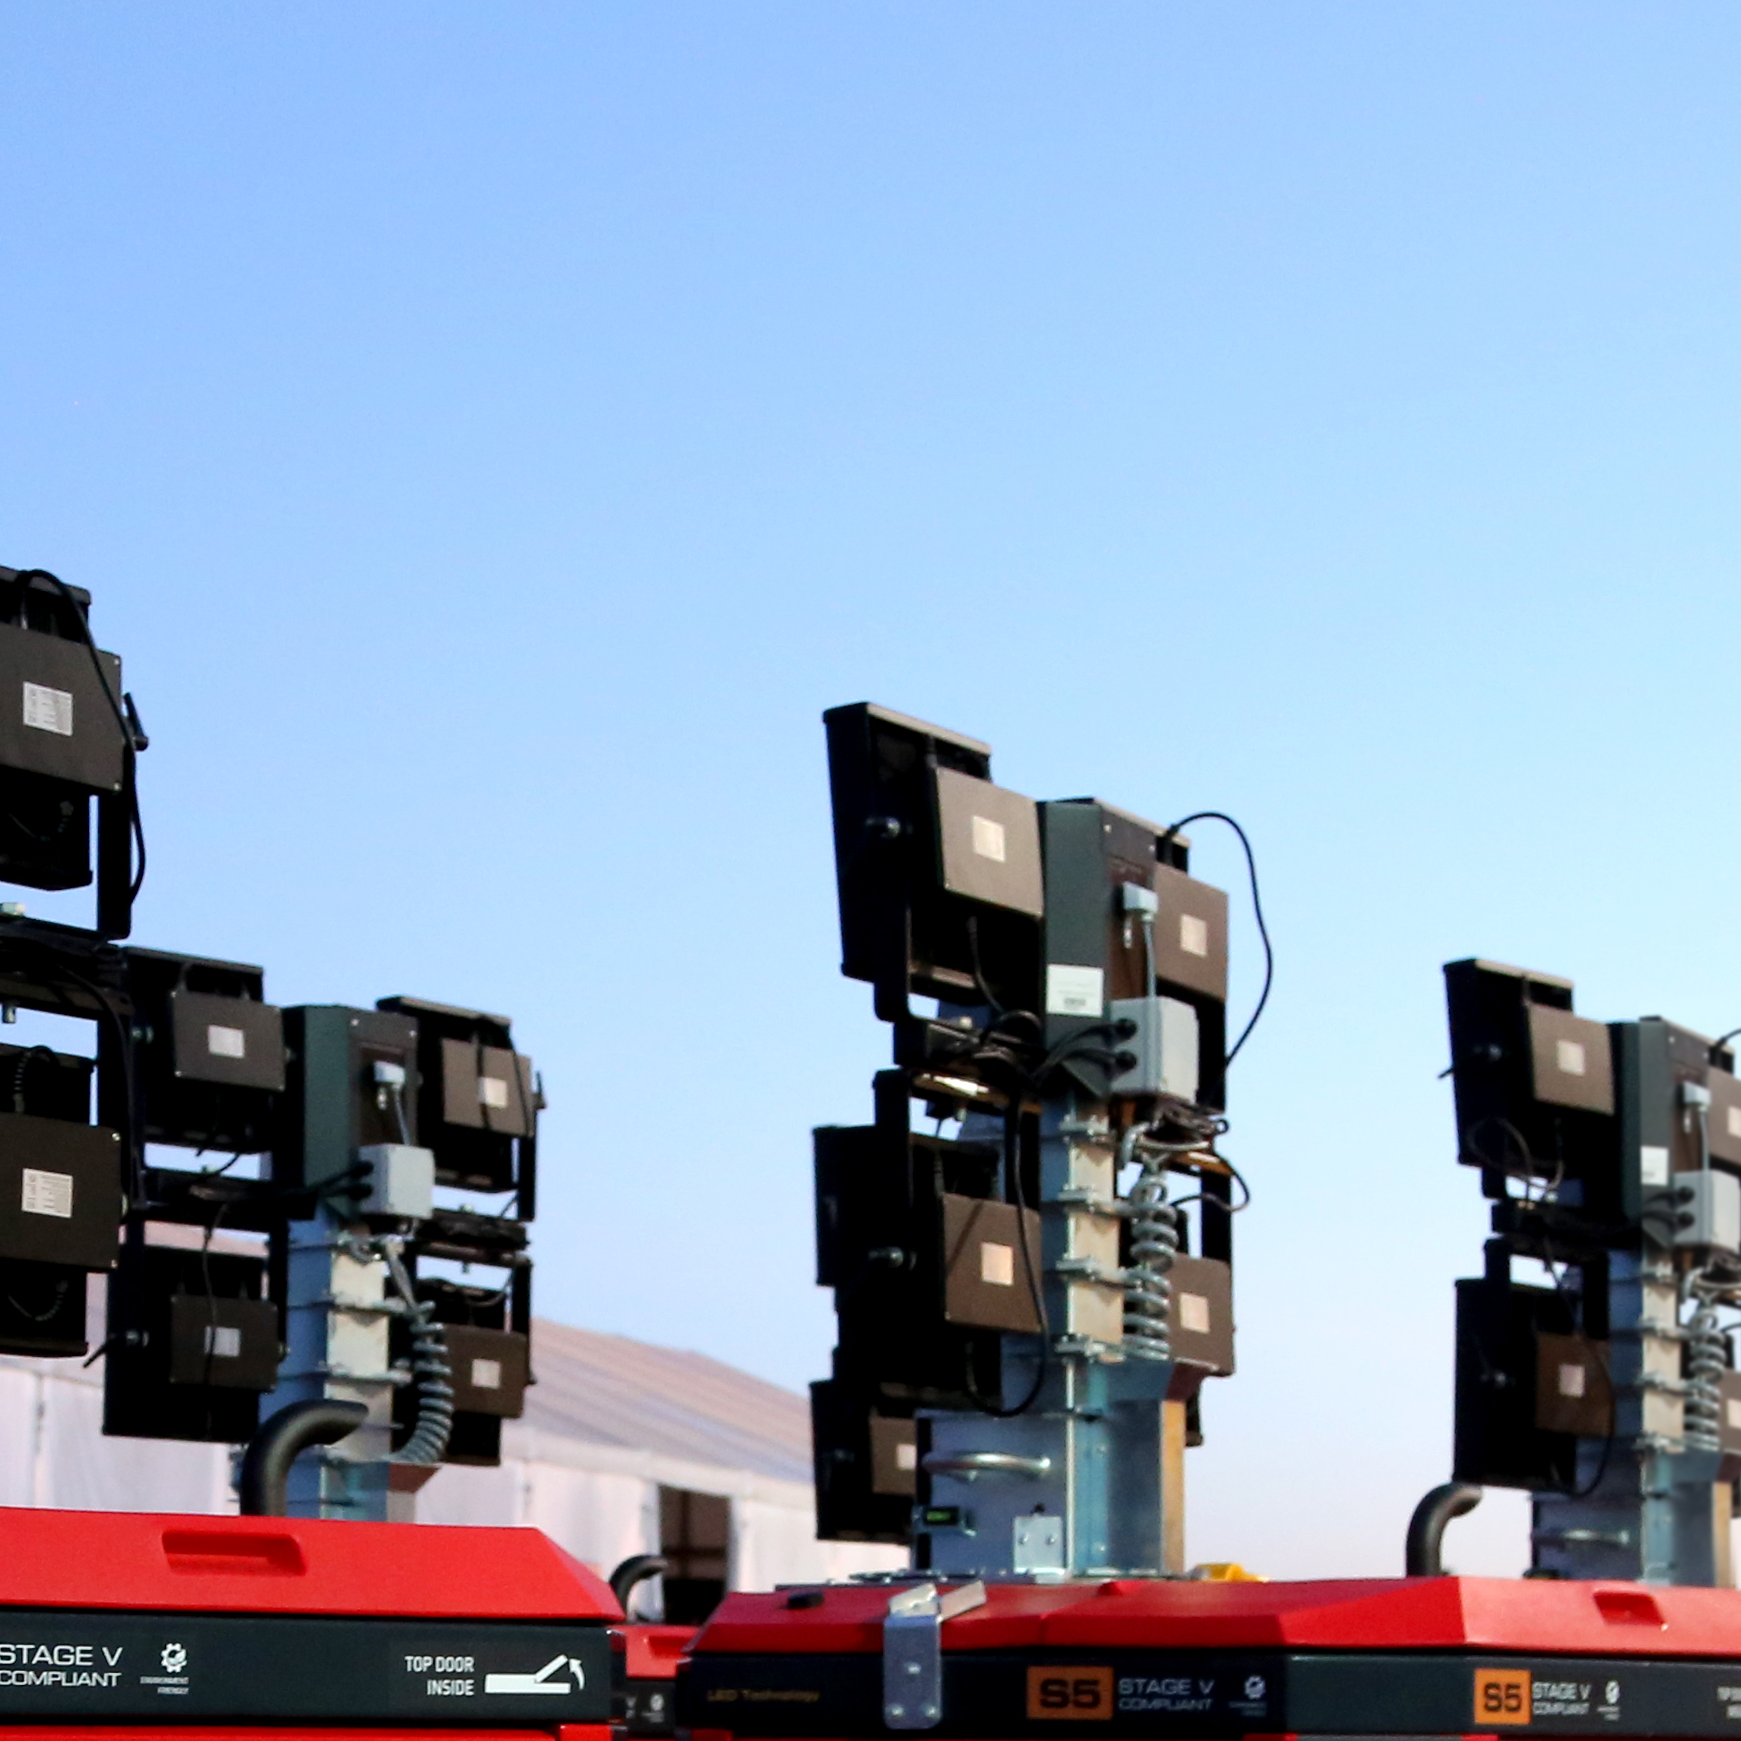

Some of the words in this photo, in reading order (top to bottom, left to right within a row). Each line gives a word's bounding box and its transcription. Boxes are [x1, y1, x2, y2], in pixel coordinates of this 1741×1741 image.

[101, 1646, 124, 1667] V
[404, 1655, 433, 1673] TOP
[434, 1656, 475, 1673] DOOR
[426, 1679, 475, 1697] INSIDE
[1038, 1678, 1103, 1710] S5
[1118, 1678, 1191, 1696] STAGE
[1198, 1680, 1215, 1696] V
[1532, 1681, 1578, 1700] STAGE
[1579, 1683, 1592, 1700] V
[1118, 1698, 1212, 1712] COMPLIANT
[1484, 1682, 1522, 1713] S5
